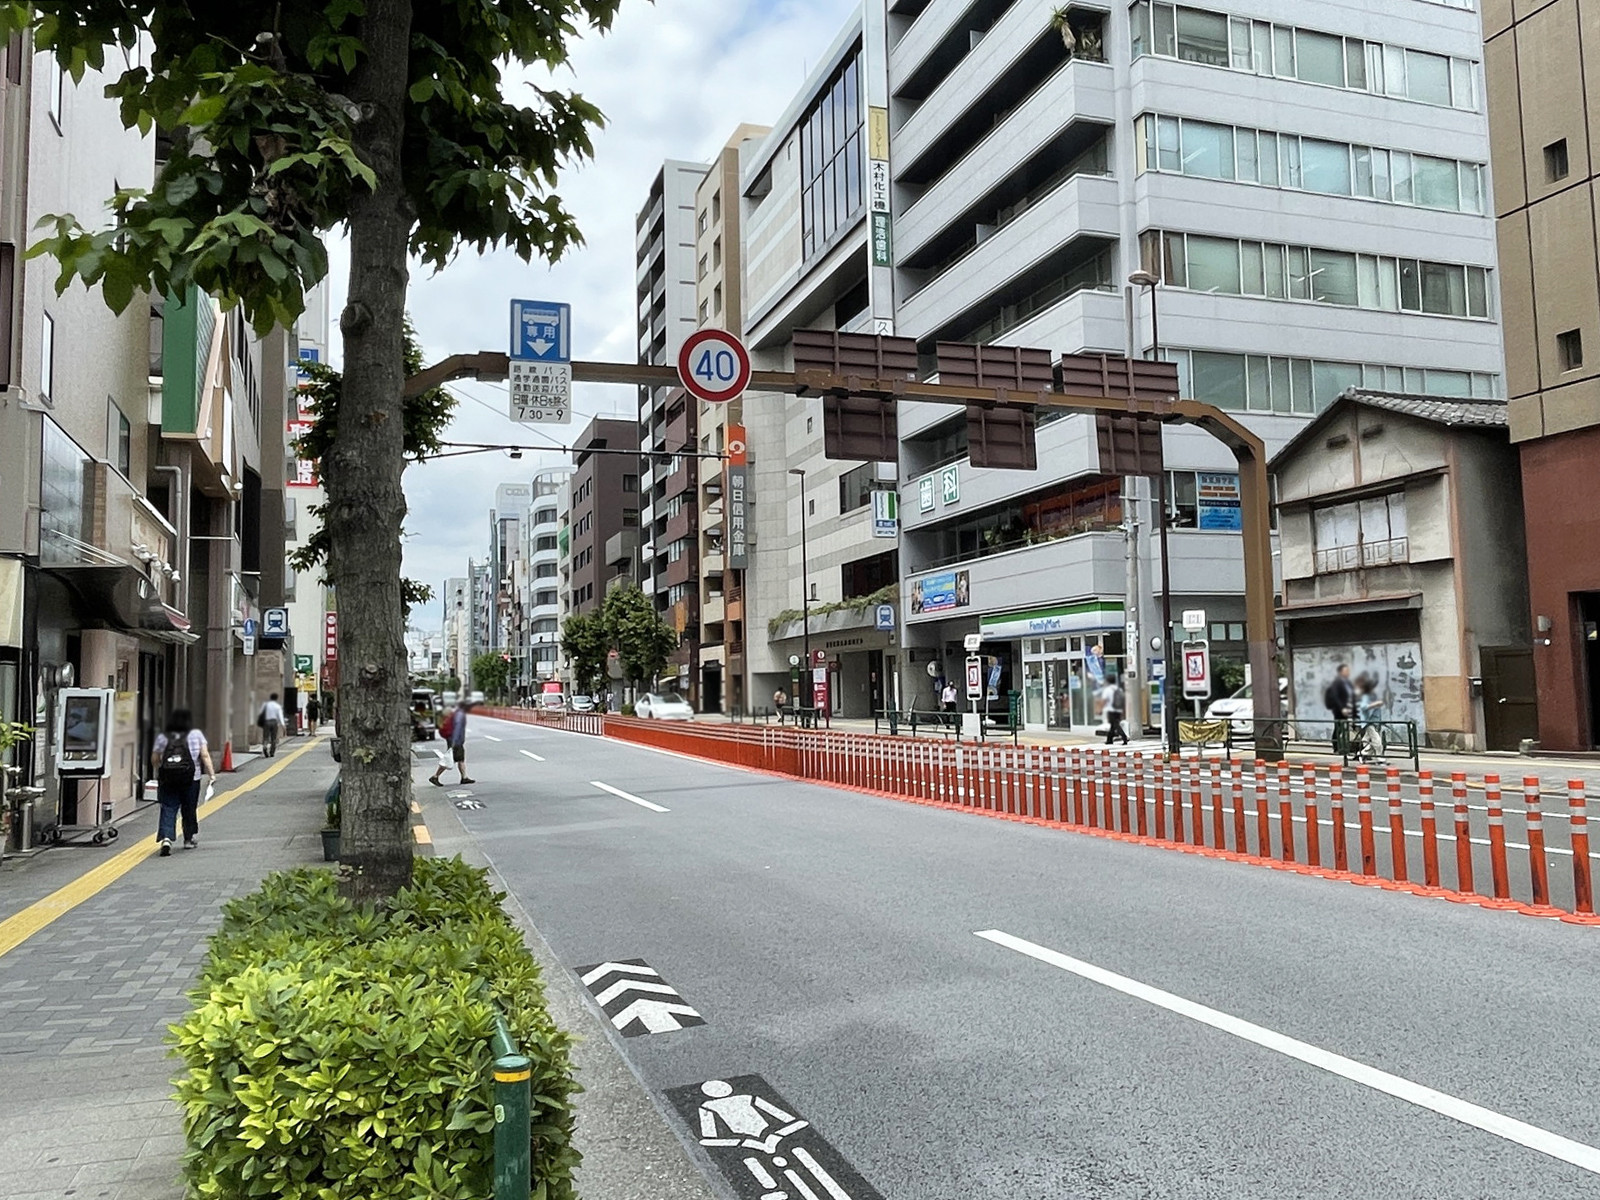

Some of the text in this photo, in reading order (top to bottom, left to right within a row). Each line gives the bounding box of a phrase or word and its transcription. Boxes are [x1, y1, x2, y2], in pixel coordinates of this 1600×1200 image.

[873, 162, 886, 210] 木村化工機
[525, 325, 556, 339] 専用
[695, 349, 734, 382] 40
[920, 469, 957, 508] 歯科
[731, 475, 746, 557] 朝日信用金庫
[1029, 619, 1061, 633] FamilyMart
